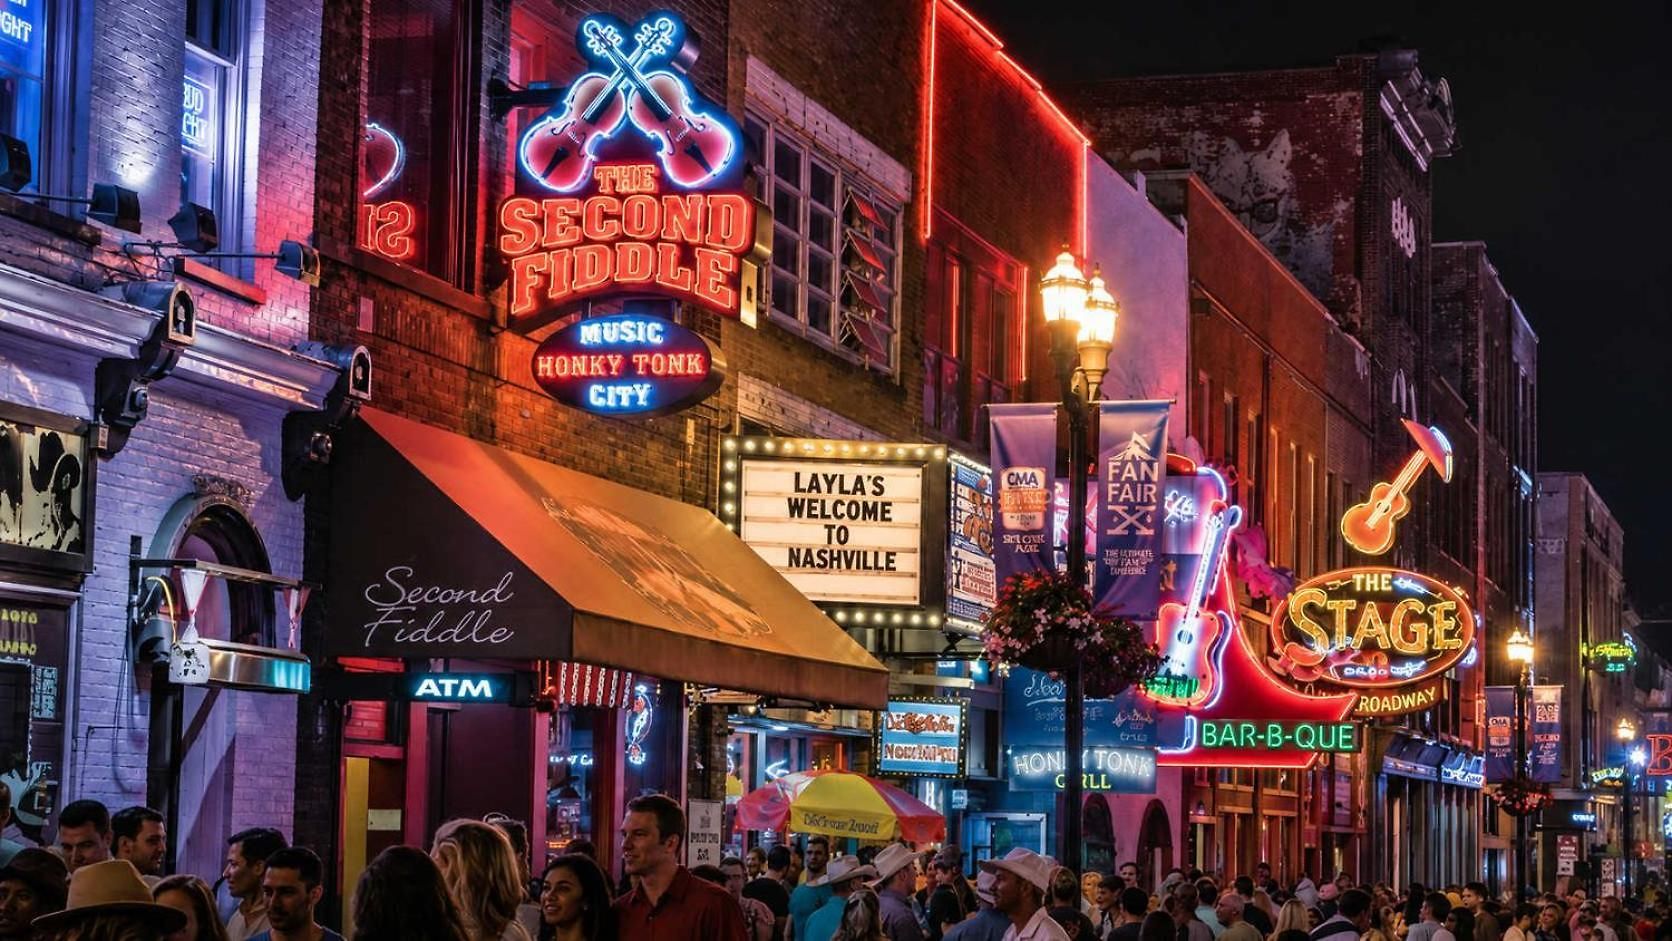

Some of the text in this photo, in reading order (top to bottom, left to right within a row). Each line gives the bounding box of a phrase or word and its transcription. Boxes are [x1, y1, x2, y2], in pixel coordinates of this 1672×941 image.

[593, 164, 657, 194] THE
[500, 194, 749, 254] SECOND
[511, 242, 739, 315] FIDDLE
[580, 320, 663, 345] MUSIC
[537, 353, 703, 377] HONKY TONK
[589, 383, 653, 407] CITY
[794, 472, 885, 497] LAYLA'S
[1007, 471, 1038, 486] CMA
[1106, 462, 1158, 482] FAN
[1107, 483, 1157, 503] FAIR
[787, 497, 893, 522] WELCOME
[823, 524, 849, 545] TO
[788, 547, 897, 572] NASHVILLE
[365, 566, 514, 607] Second
[1352, 574, 1392, 592] THE
[364, 604, 514, 647] Fiddle
[1288, 588, 1463, 654] STAGE
[414, 679, 493, 698] ATM
[1355, 687, 1436, 713] ROADWAY
[1202, 722, 1354, 750] BAR-B-QUE
[1013, 750, 1154, 778] HONY TONK
